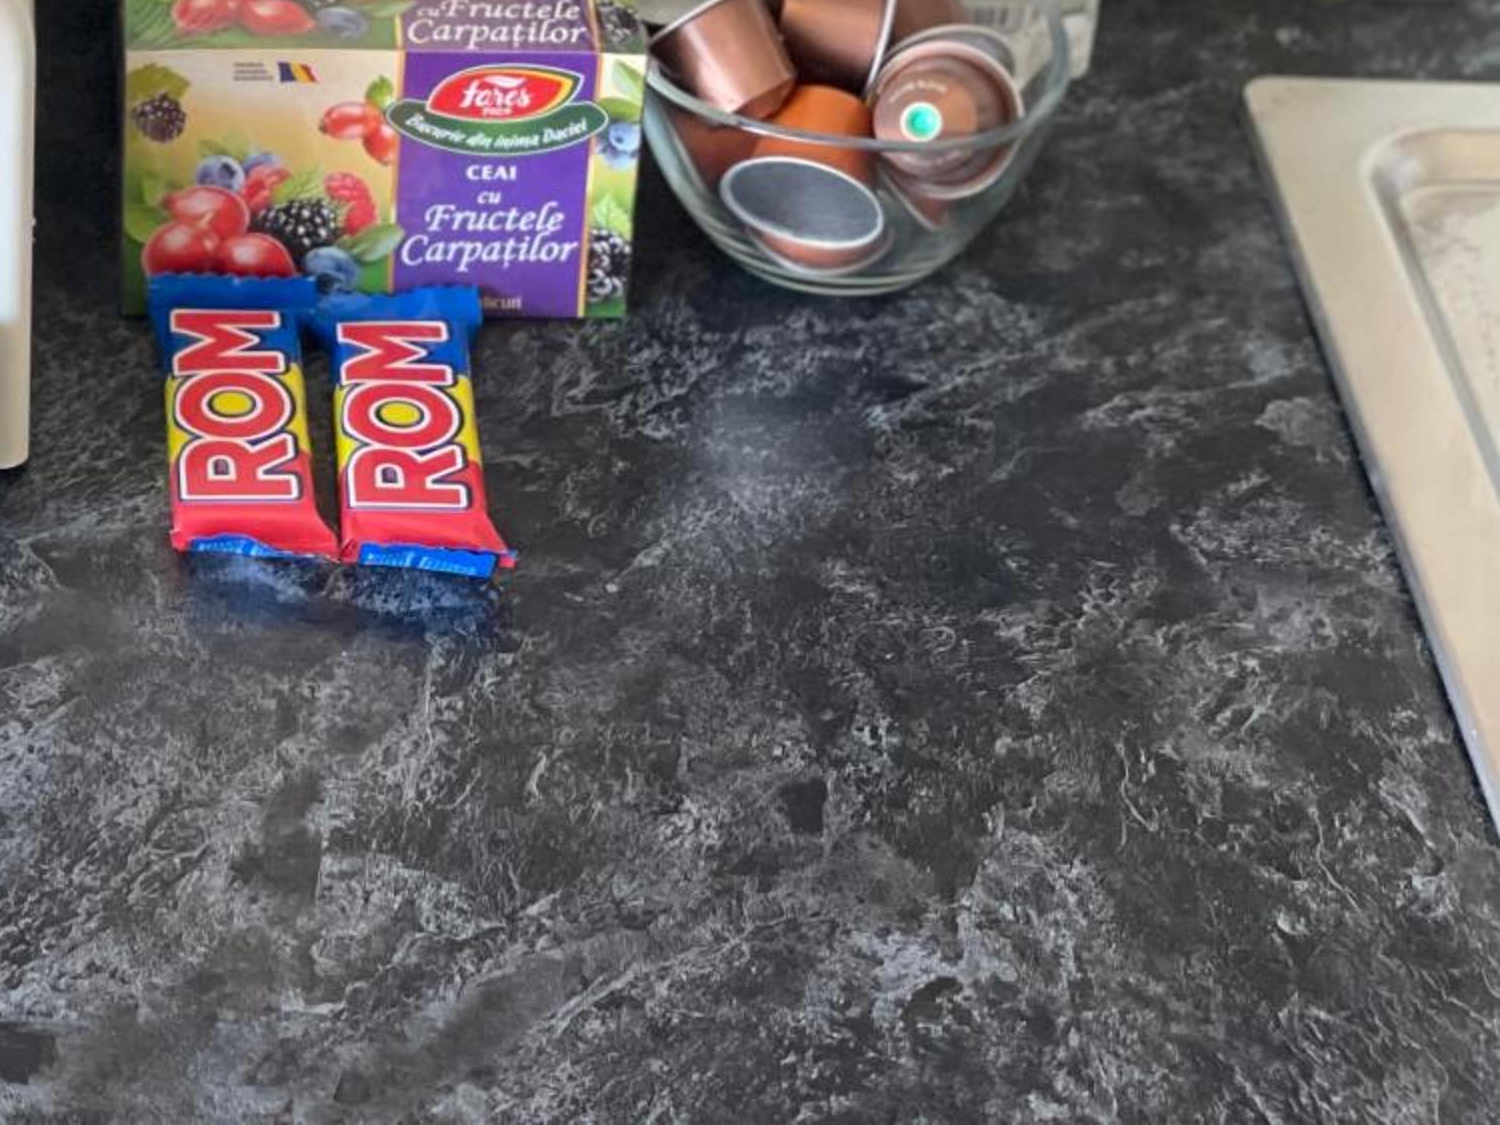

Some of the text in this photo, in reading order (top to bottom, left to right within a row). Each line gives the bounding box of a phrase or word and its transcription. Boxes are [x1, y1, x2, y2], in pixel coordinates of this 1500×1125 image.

[416, 6, 440, 17] cu
[407, 18, 587, 50] Carpaților
[466, 164, 518, 181] CEAI
[476, 191, 502, 205] cu
[424, 201, 566, 233] Fructele
[401, 231, 579, 272] Carpaților
[169, 308, 300, 502] ROM
[336, 320, 470, 509] ROM
